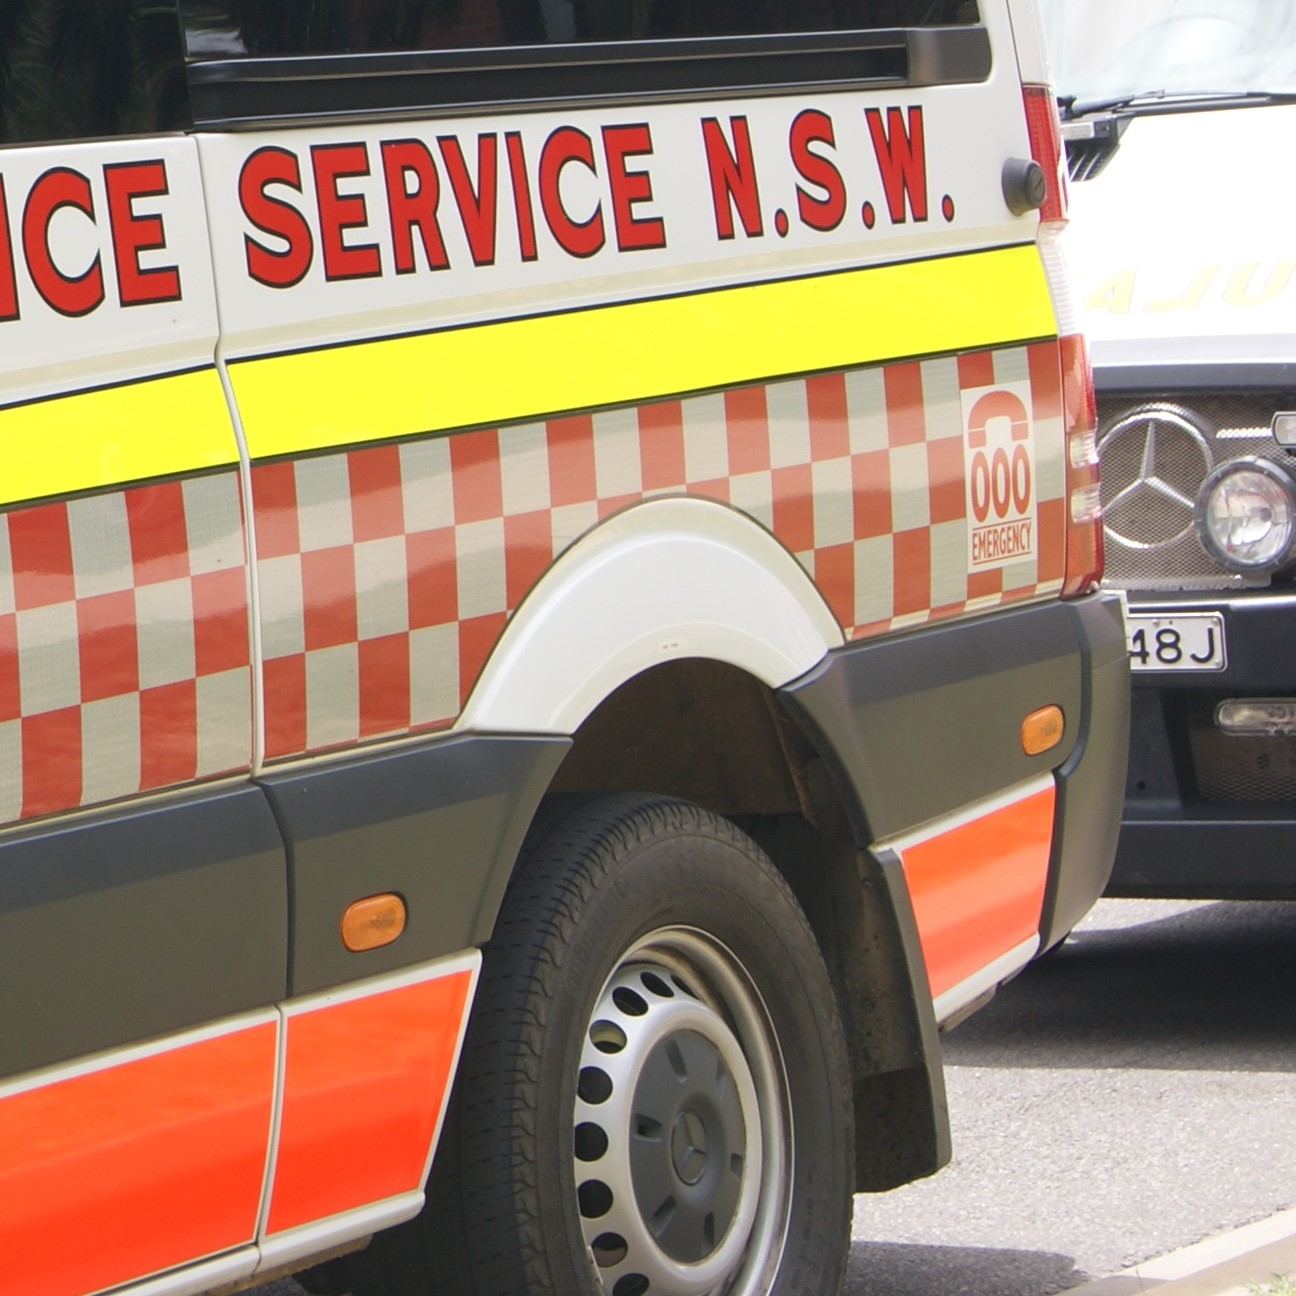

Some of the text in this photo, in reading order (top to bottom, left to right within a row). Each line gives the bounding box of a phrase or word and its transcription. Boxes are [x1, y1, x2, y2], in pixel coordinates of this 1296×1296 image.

[237, 123, 667, 290] SERVICE
[701, 104, 956, 241] N.S.W.
[970, 443, 1031, 523] 000
[972, 522, 1032, 562] EMERGENCY
